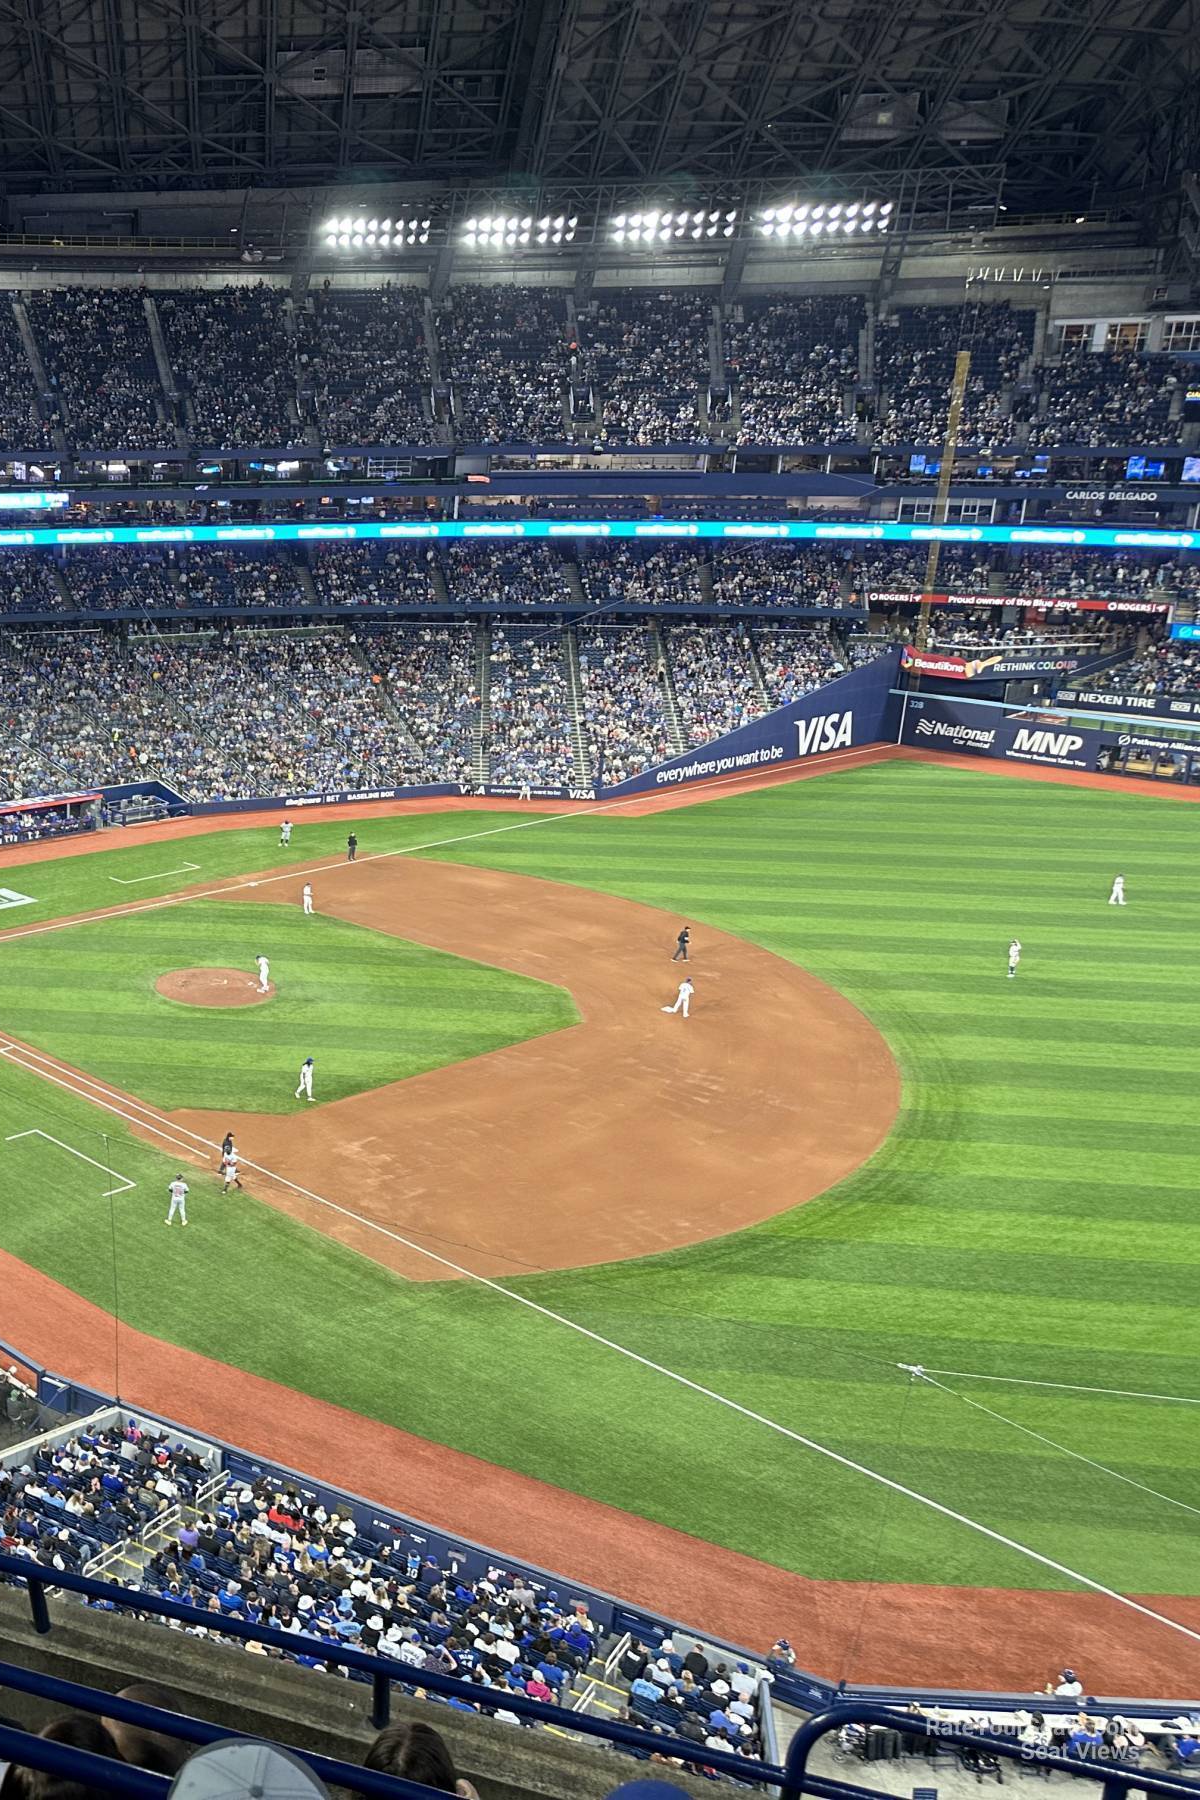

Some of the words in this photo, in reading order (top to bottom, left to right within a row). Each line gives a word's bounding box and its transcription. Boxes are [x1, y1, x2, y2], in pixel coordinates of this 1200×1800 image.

[1065, 491, 1105, 500] CARLOS
[1108, 491, 1158, 501] DELGADO
[947, 595, 975, 604] Proud
[975, 597, 1005, 605] owner
[1005, 597, 1016, 606] of
[1016, 598, 1032, 606] the
[1032, 599, 1054, 608] Blue
[1054, 600, 1078, 611] Jays
[1117, 603, 1152, 612] ROGERS
[993, 661, 1035, 672] RETHINK
[1036, 660, 1078, 670] COLOUR
[1078, 693, 1123, 706] NEXEN
[1125, 696, 1157, 709] TIRE
[793, 710, 853, 756] VISA
[966, 740, 991, 749] Rental
[1012, 728, 1084, 756] MNP
[1131, 737, 1169, 748] Pathways
[656, 757, 716, 783] everywhere
[715, 756, 735, 774] you
[736, 750, 759, 766] want
[759, 748, 770, 761] to
[771, 745, 784, 759] be
[325, 795, 341, 803] BET
[347, 792, 380, 800] BASELINE
[380, 790, 395, 798] BOX
[567, 789, 596, 800] VISA
[407, 1566, 419, 1579] 10
[1033, 1733, 1049, 1745] 26
